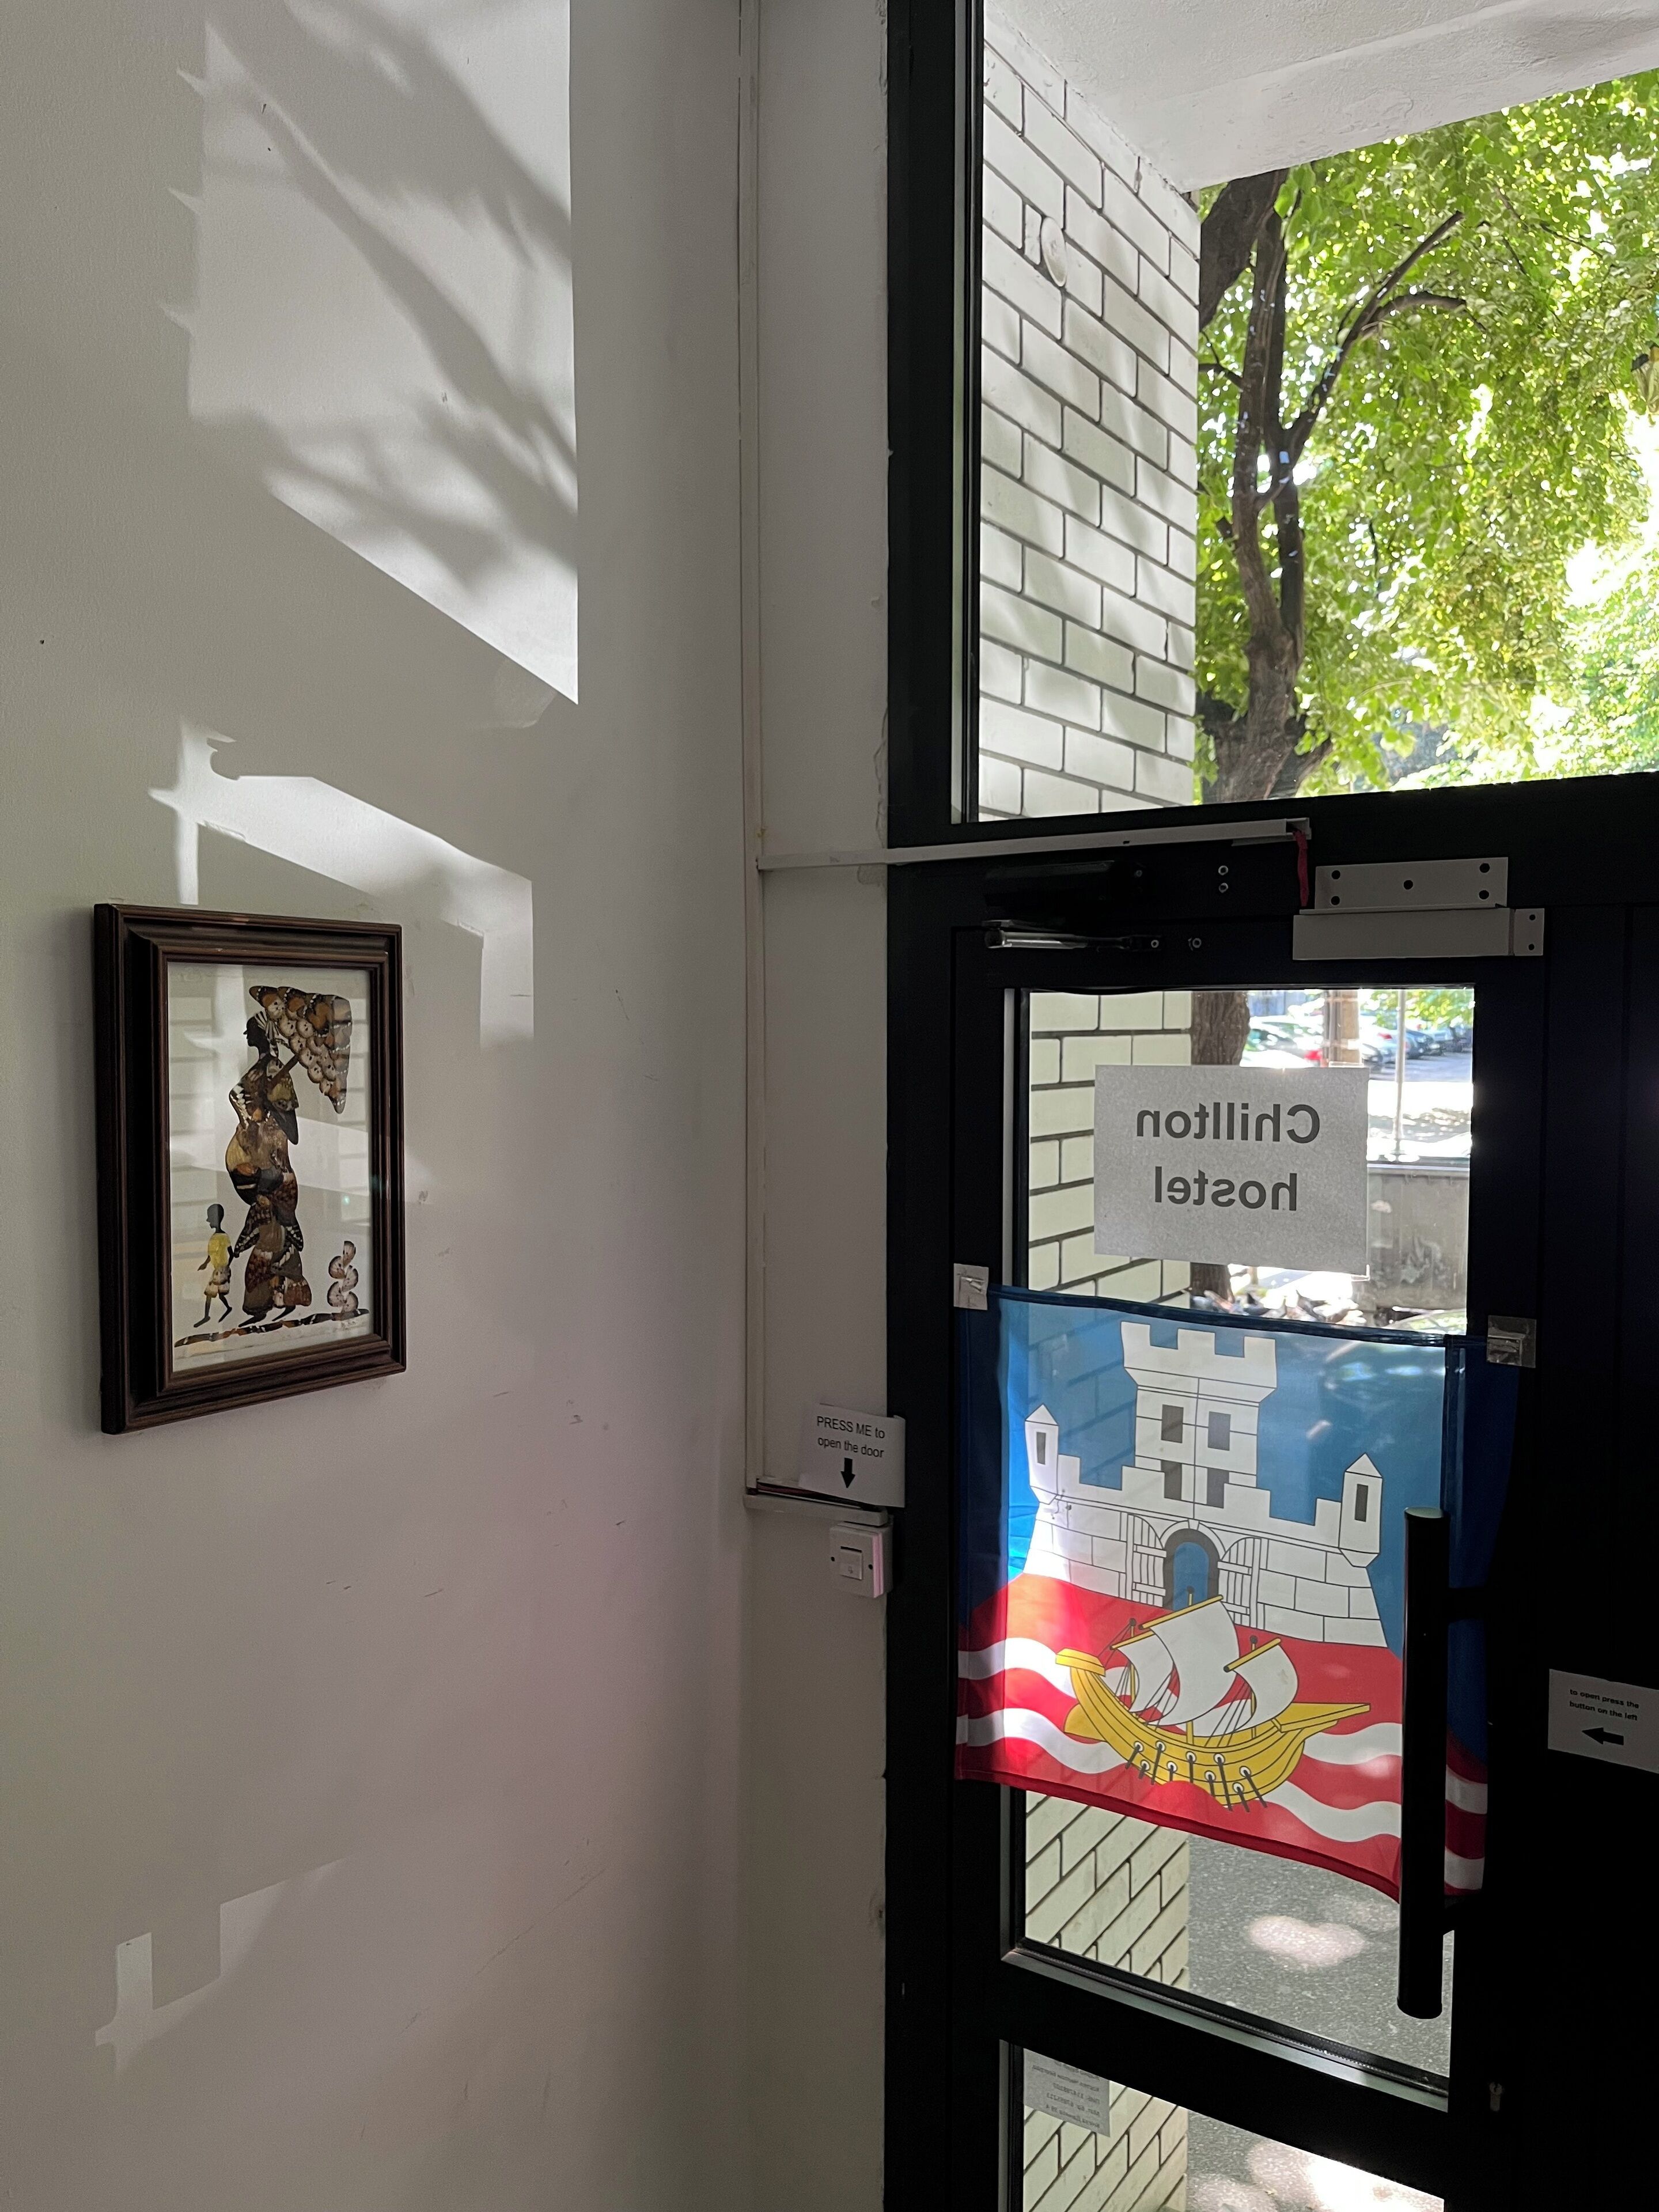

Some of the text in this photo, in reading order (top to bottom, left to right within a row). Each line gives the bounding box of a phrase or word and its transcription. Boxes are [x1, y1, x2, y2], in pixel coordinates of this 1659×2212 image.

[816, 1416, 885, 1438] PRESS ME to
[817, 1437, 884, 1458] open the door
[1569, 1700, 1596, 1711] button
[1609, 1710, 1623, 1718] the
[1624, 1712, 1638, 1721] left
[1580, 1692, 1600, 1700] open
[1602, 1696, 1624, 1706] press
[1627, 1700, 1639, 1709] the
